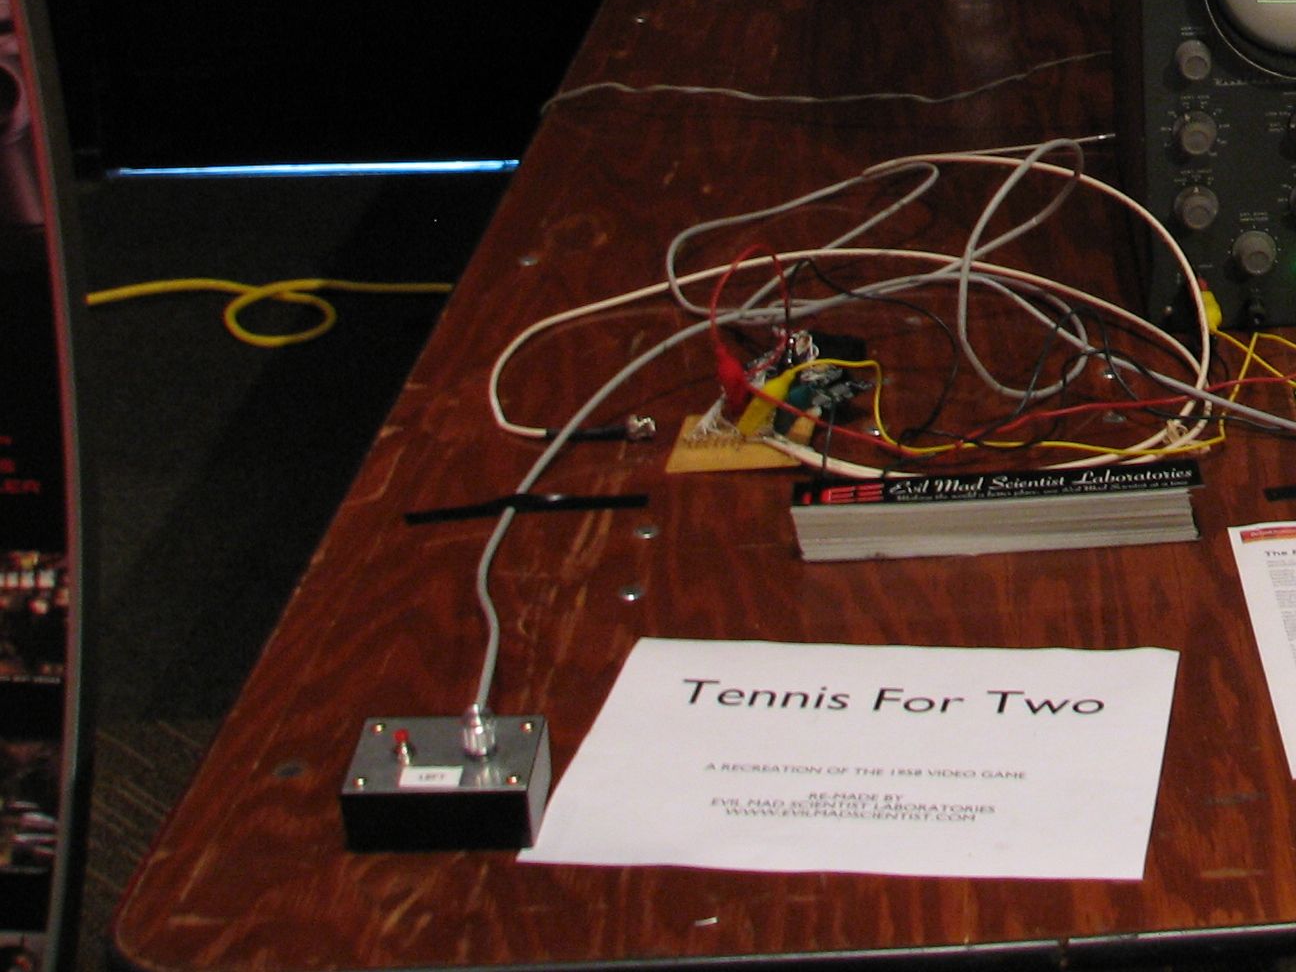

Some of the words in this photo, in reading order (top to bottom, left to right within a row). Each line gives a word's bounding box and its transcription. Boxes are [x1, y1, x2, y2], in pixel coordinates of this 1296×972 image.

[890, 478, 930, 494] Evil
[934, 476, 984, 493] Mad
[987, 475, 1066, 491] Scientist
[1071, 467, 1194, 485] Laboratories
[1264, 549, 1288, 557] The
[683, 678, 850, 712] Tennis
[874, 687, 965, 714] For
[987, 690, 1106, 716] Two
[705, 763, 717, 772] A
[720, 763, 823, 775] RECREATION
[826, 766, 849, 776] OF
[854, 767, 884, 777] THE
[927, 769, 977, 779] VIDEO
[981, 770, 1027, 780] GAME
[711, 796, 745, 808] EVIL
[748, 798, 785, 809] MAD
[790, 799, 869, 811] SCIENTIST
[873, 801, 998, 814] LABORATORIES
[884, 792, 904, 802] BY
[725, 807, 979, 821] WWW.EVILMADSCIENTIST.COM
